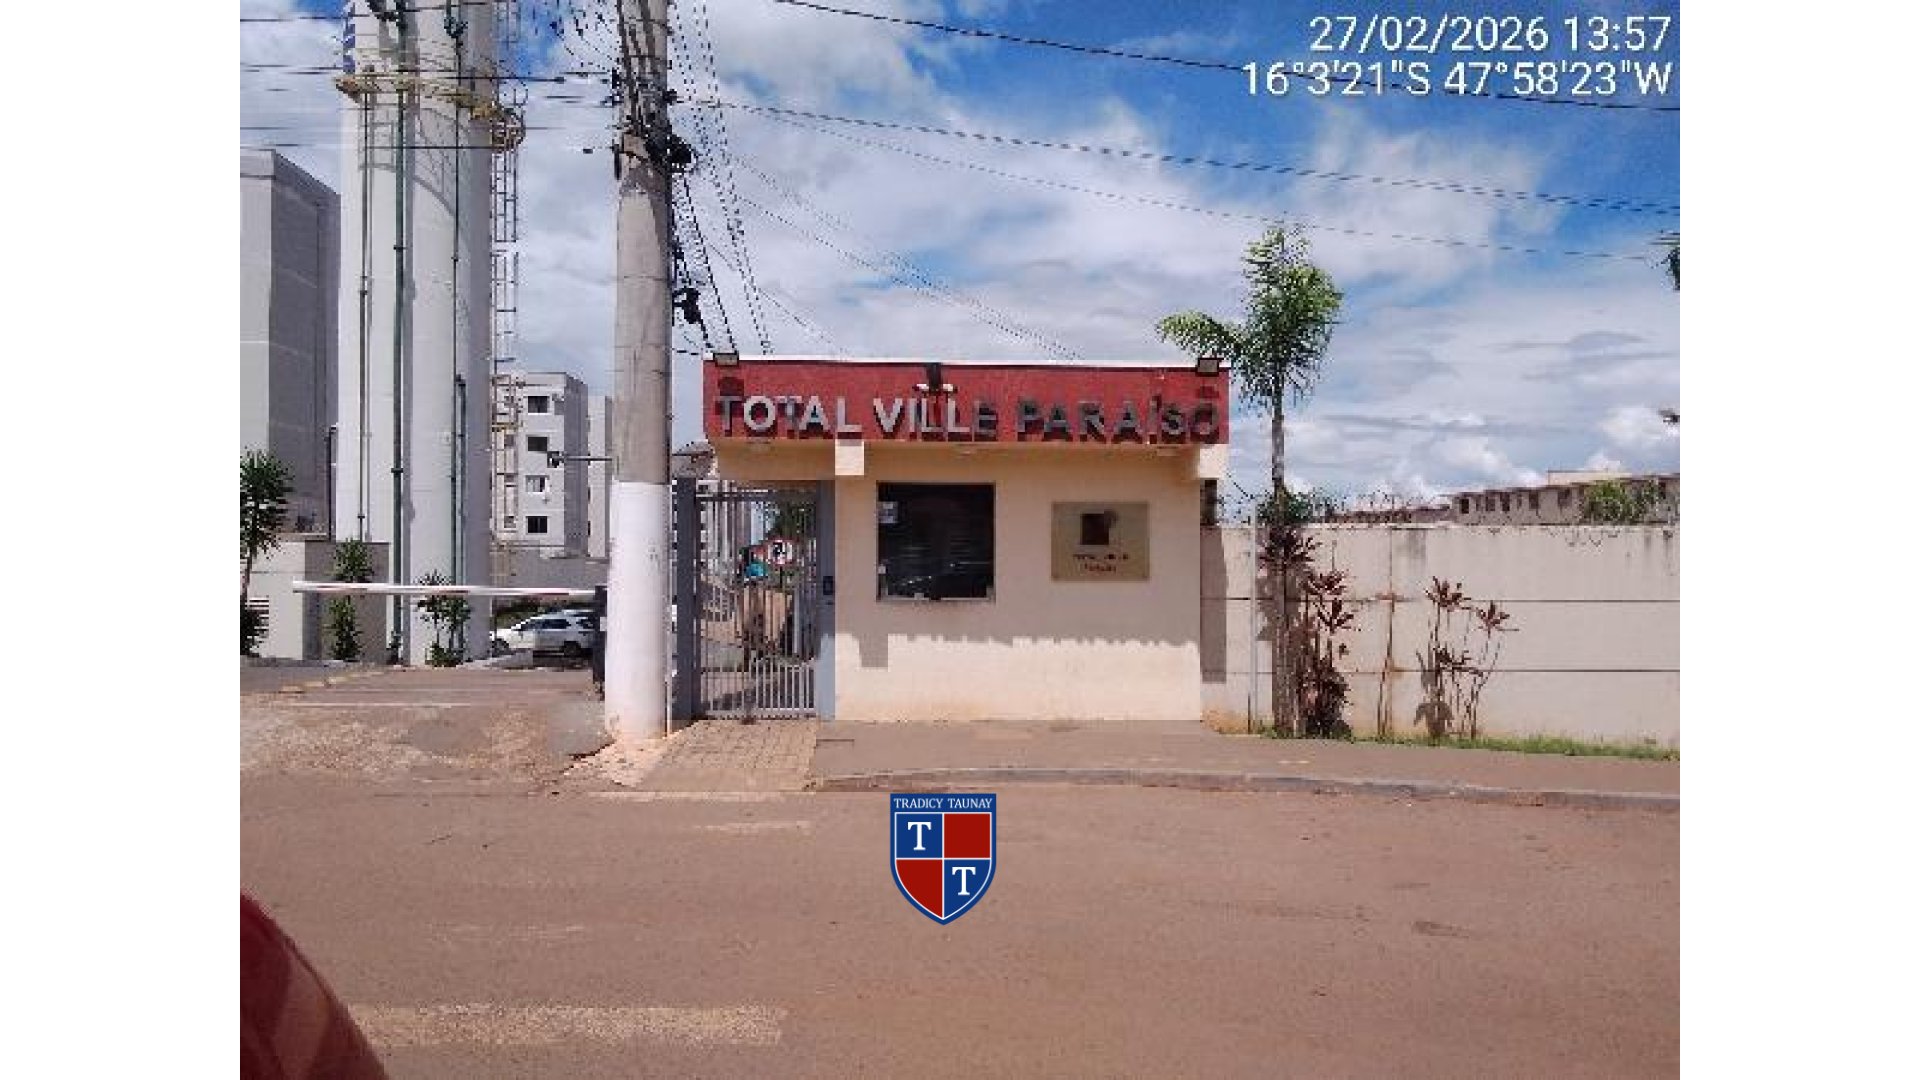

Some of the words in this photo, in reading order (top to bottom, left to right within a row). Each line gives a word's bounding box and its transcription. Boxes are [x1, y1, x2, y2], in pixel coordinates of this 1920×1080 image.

[714, 395, 863, 433] TOTAL
[872, 397, 998, 435] VILLE
[1016, 395, 1219, 436] PARAÍSO
